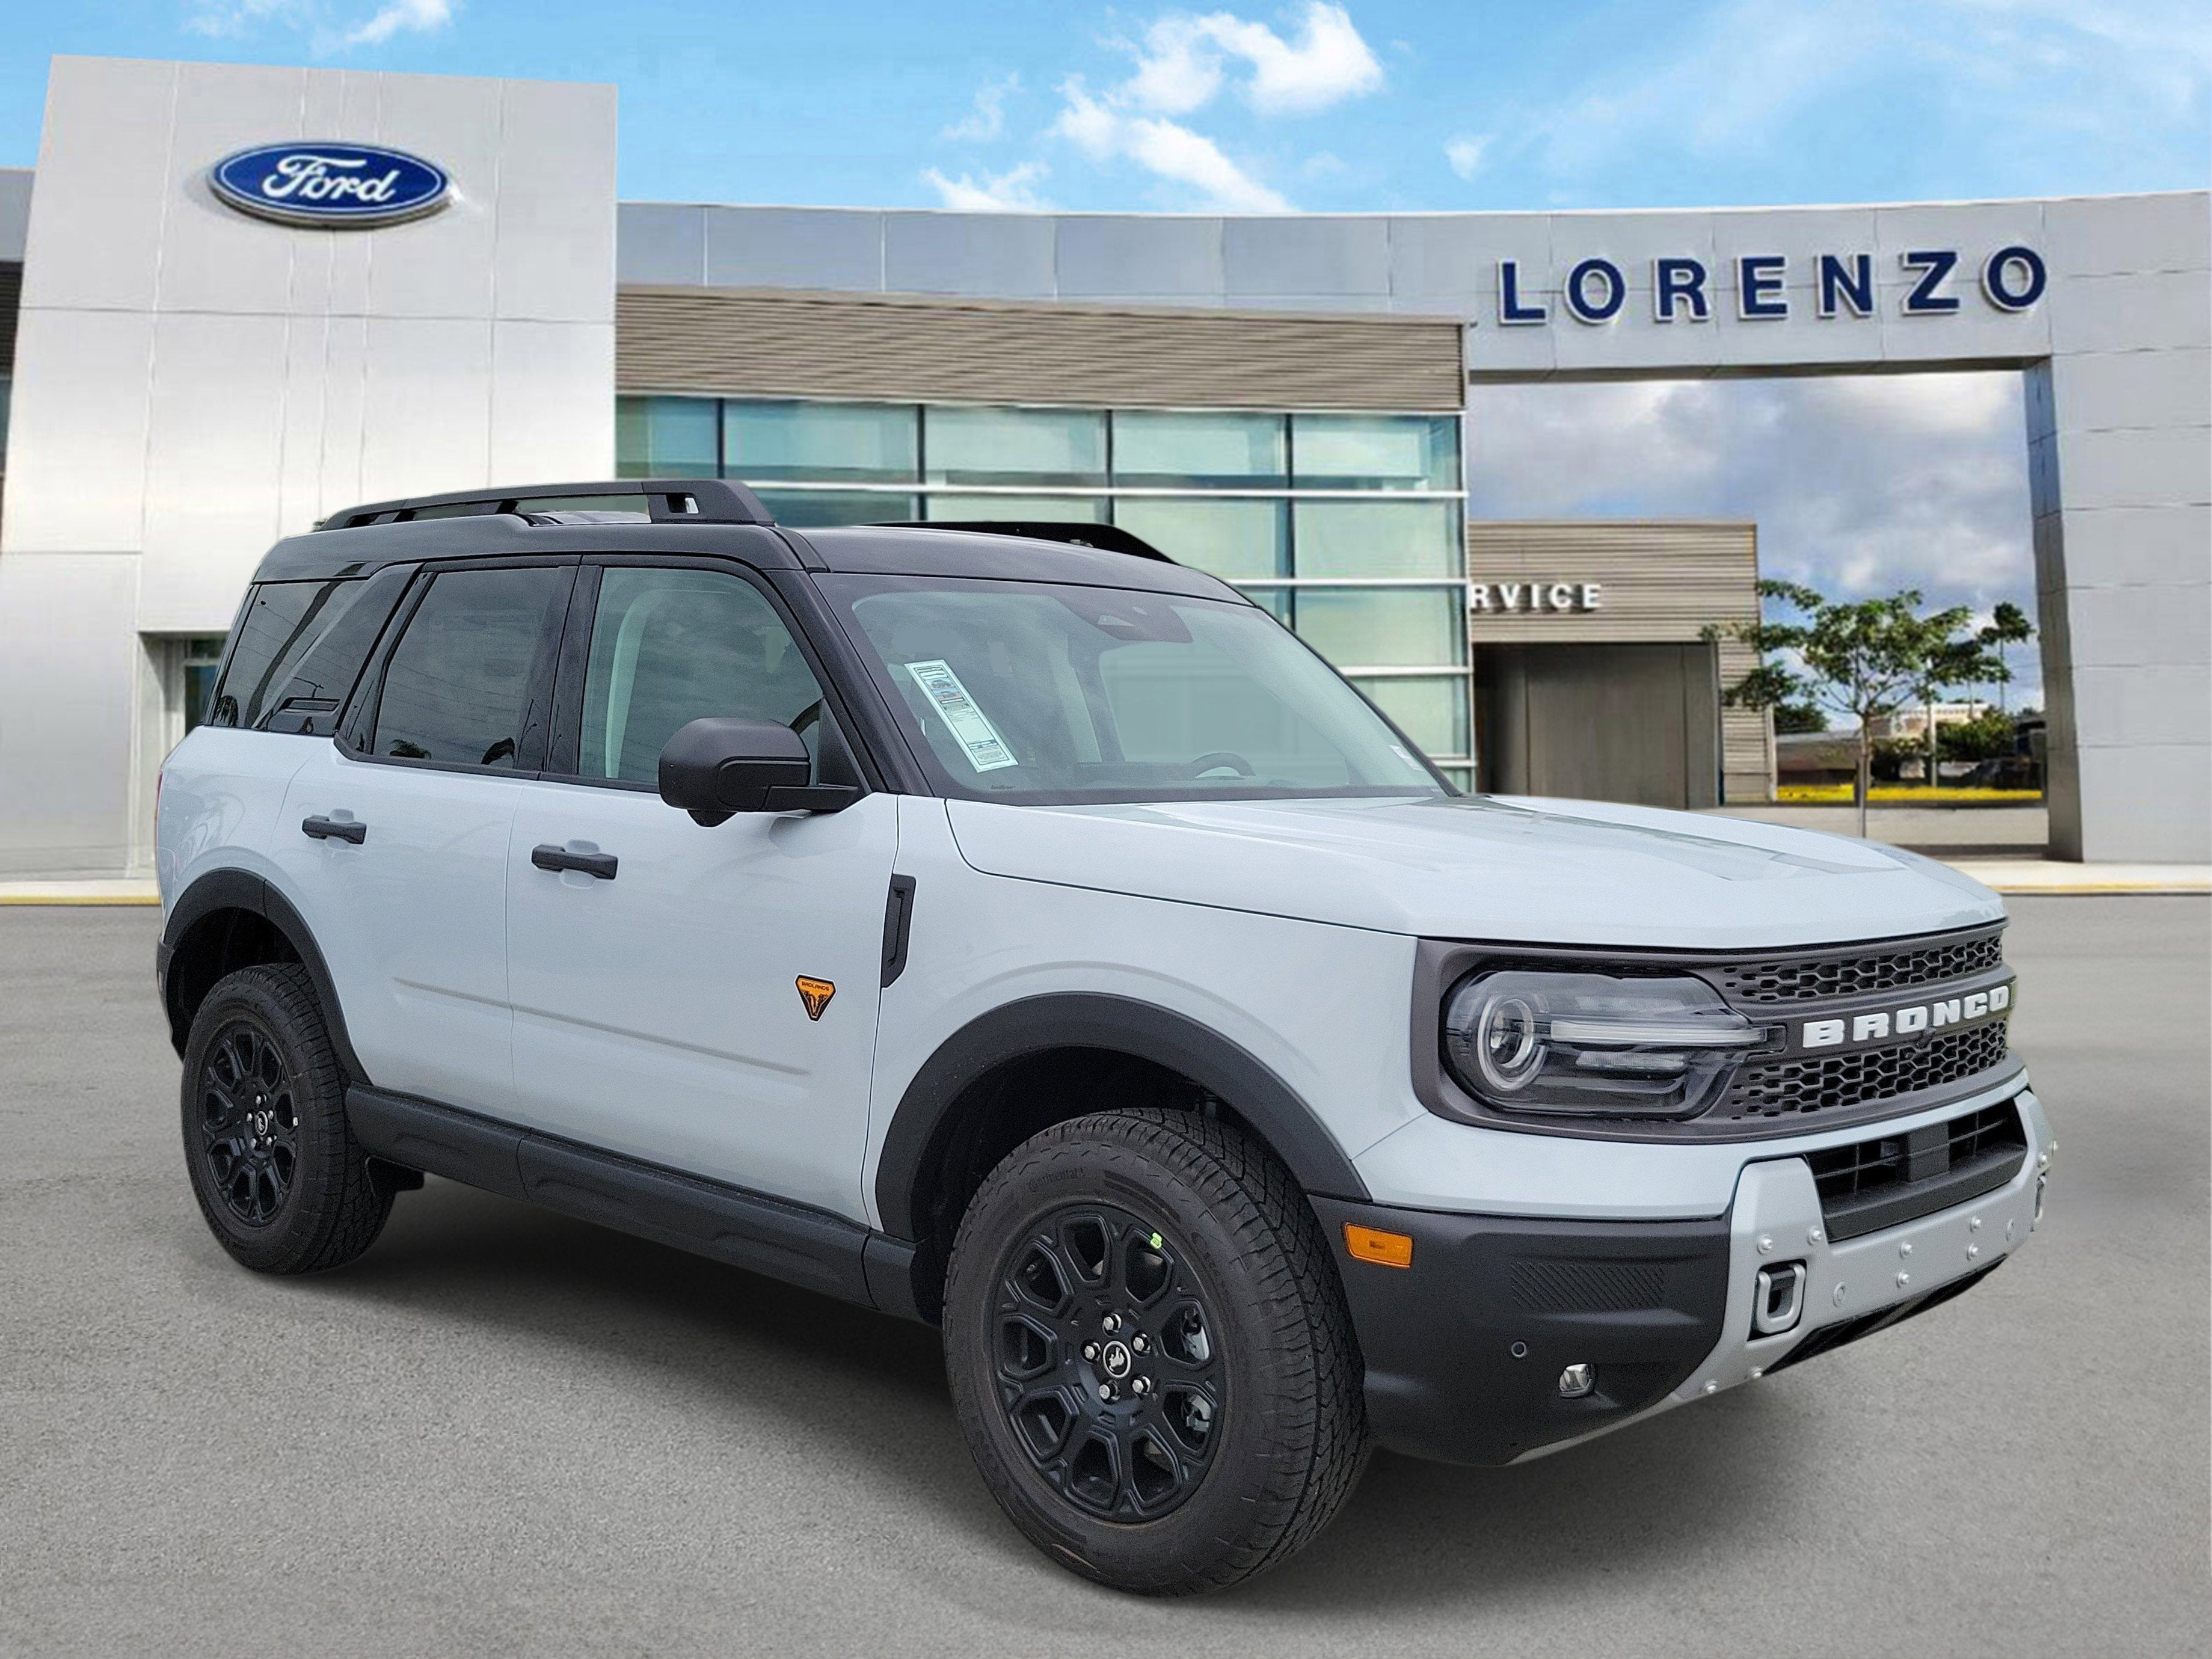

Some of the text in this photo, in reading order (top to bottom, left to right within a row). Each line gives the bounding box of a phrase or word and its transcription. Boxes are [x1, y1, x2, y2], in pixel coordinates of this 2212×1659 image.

[262, 155, 400, 202] Ford
[1498, 245, 2047, 325] LORENZO
[1803, 986, 2009, 1048] BRONCO
